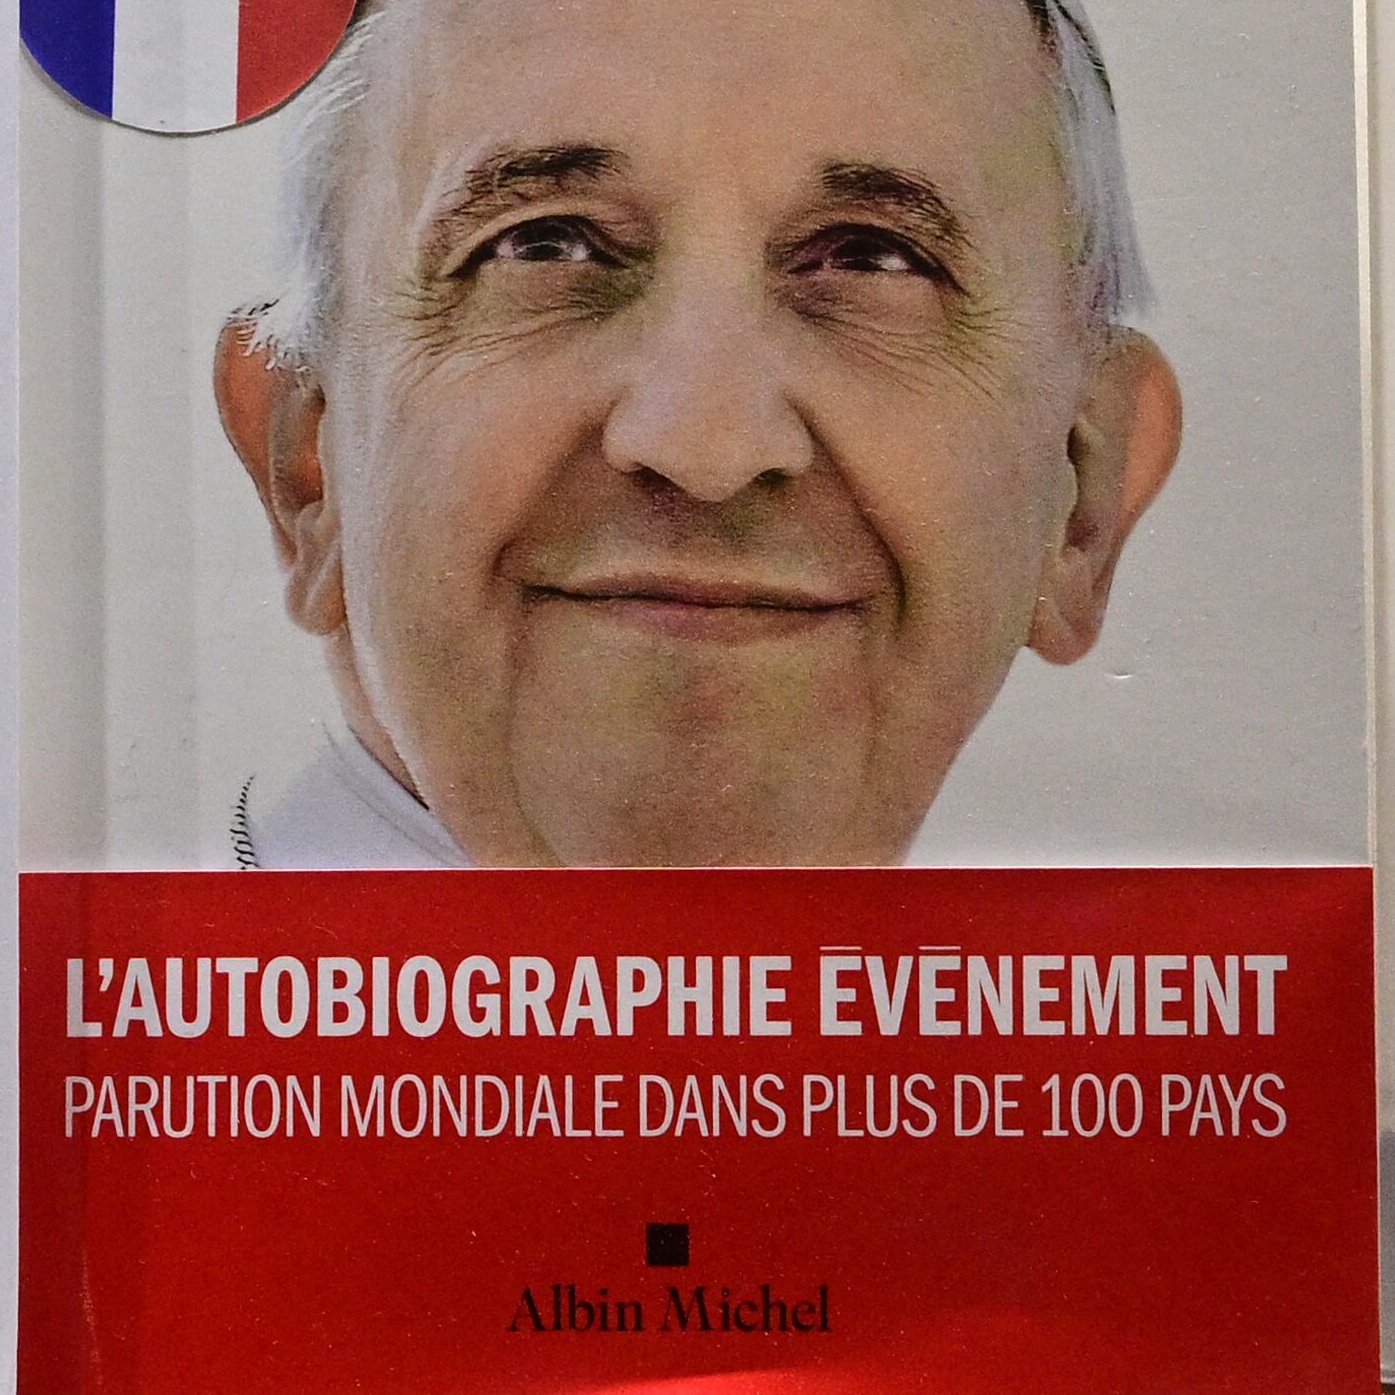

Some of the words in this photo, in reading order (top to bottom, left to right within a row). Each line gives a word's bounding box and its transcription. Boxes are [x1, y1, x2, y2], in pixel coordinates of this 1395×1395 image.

[67, 956, 791, 1038] L’AUTOBIOGRAPHIE
[66, 1075, 320, 1138] PARUTION
[342, 1074, 623, 1137] MONDIALE
[640, 1074, 785, 1137] DANS
[804, 1074, 936, 1137] PLUS
[955, 1075, 1023, 1136] DE
[1042, 1074, 1142, 1137] 100
[1162, 1074, 1285, 1136] PAYS
[509, 1284, 644, 1332] Albin
[660, 1284, 831, 1333] Michel
